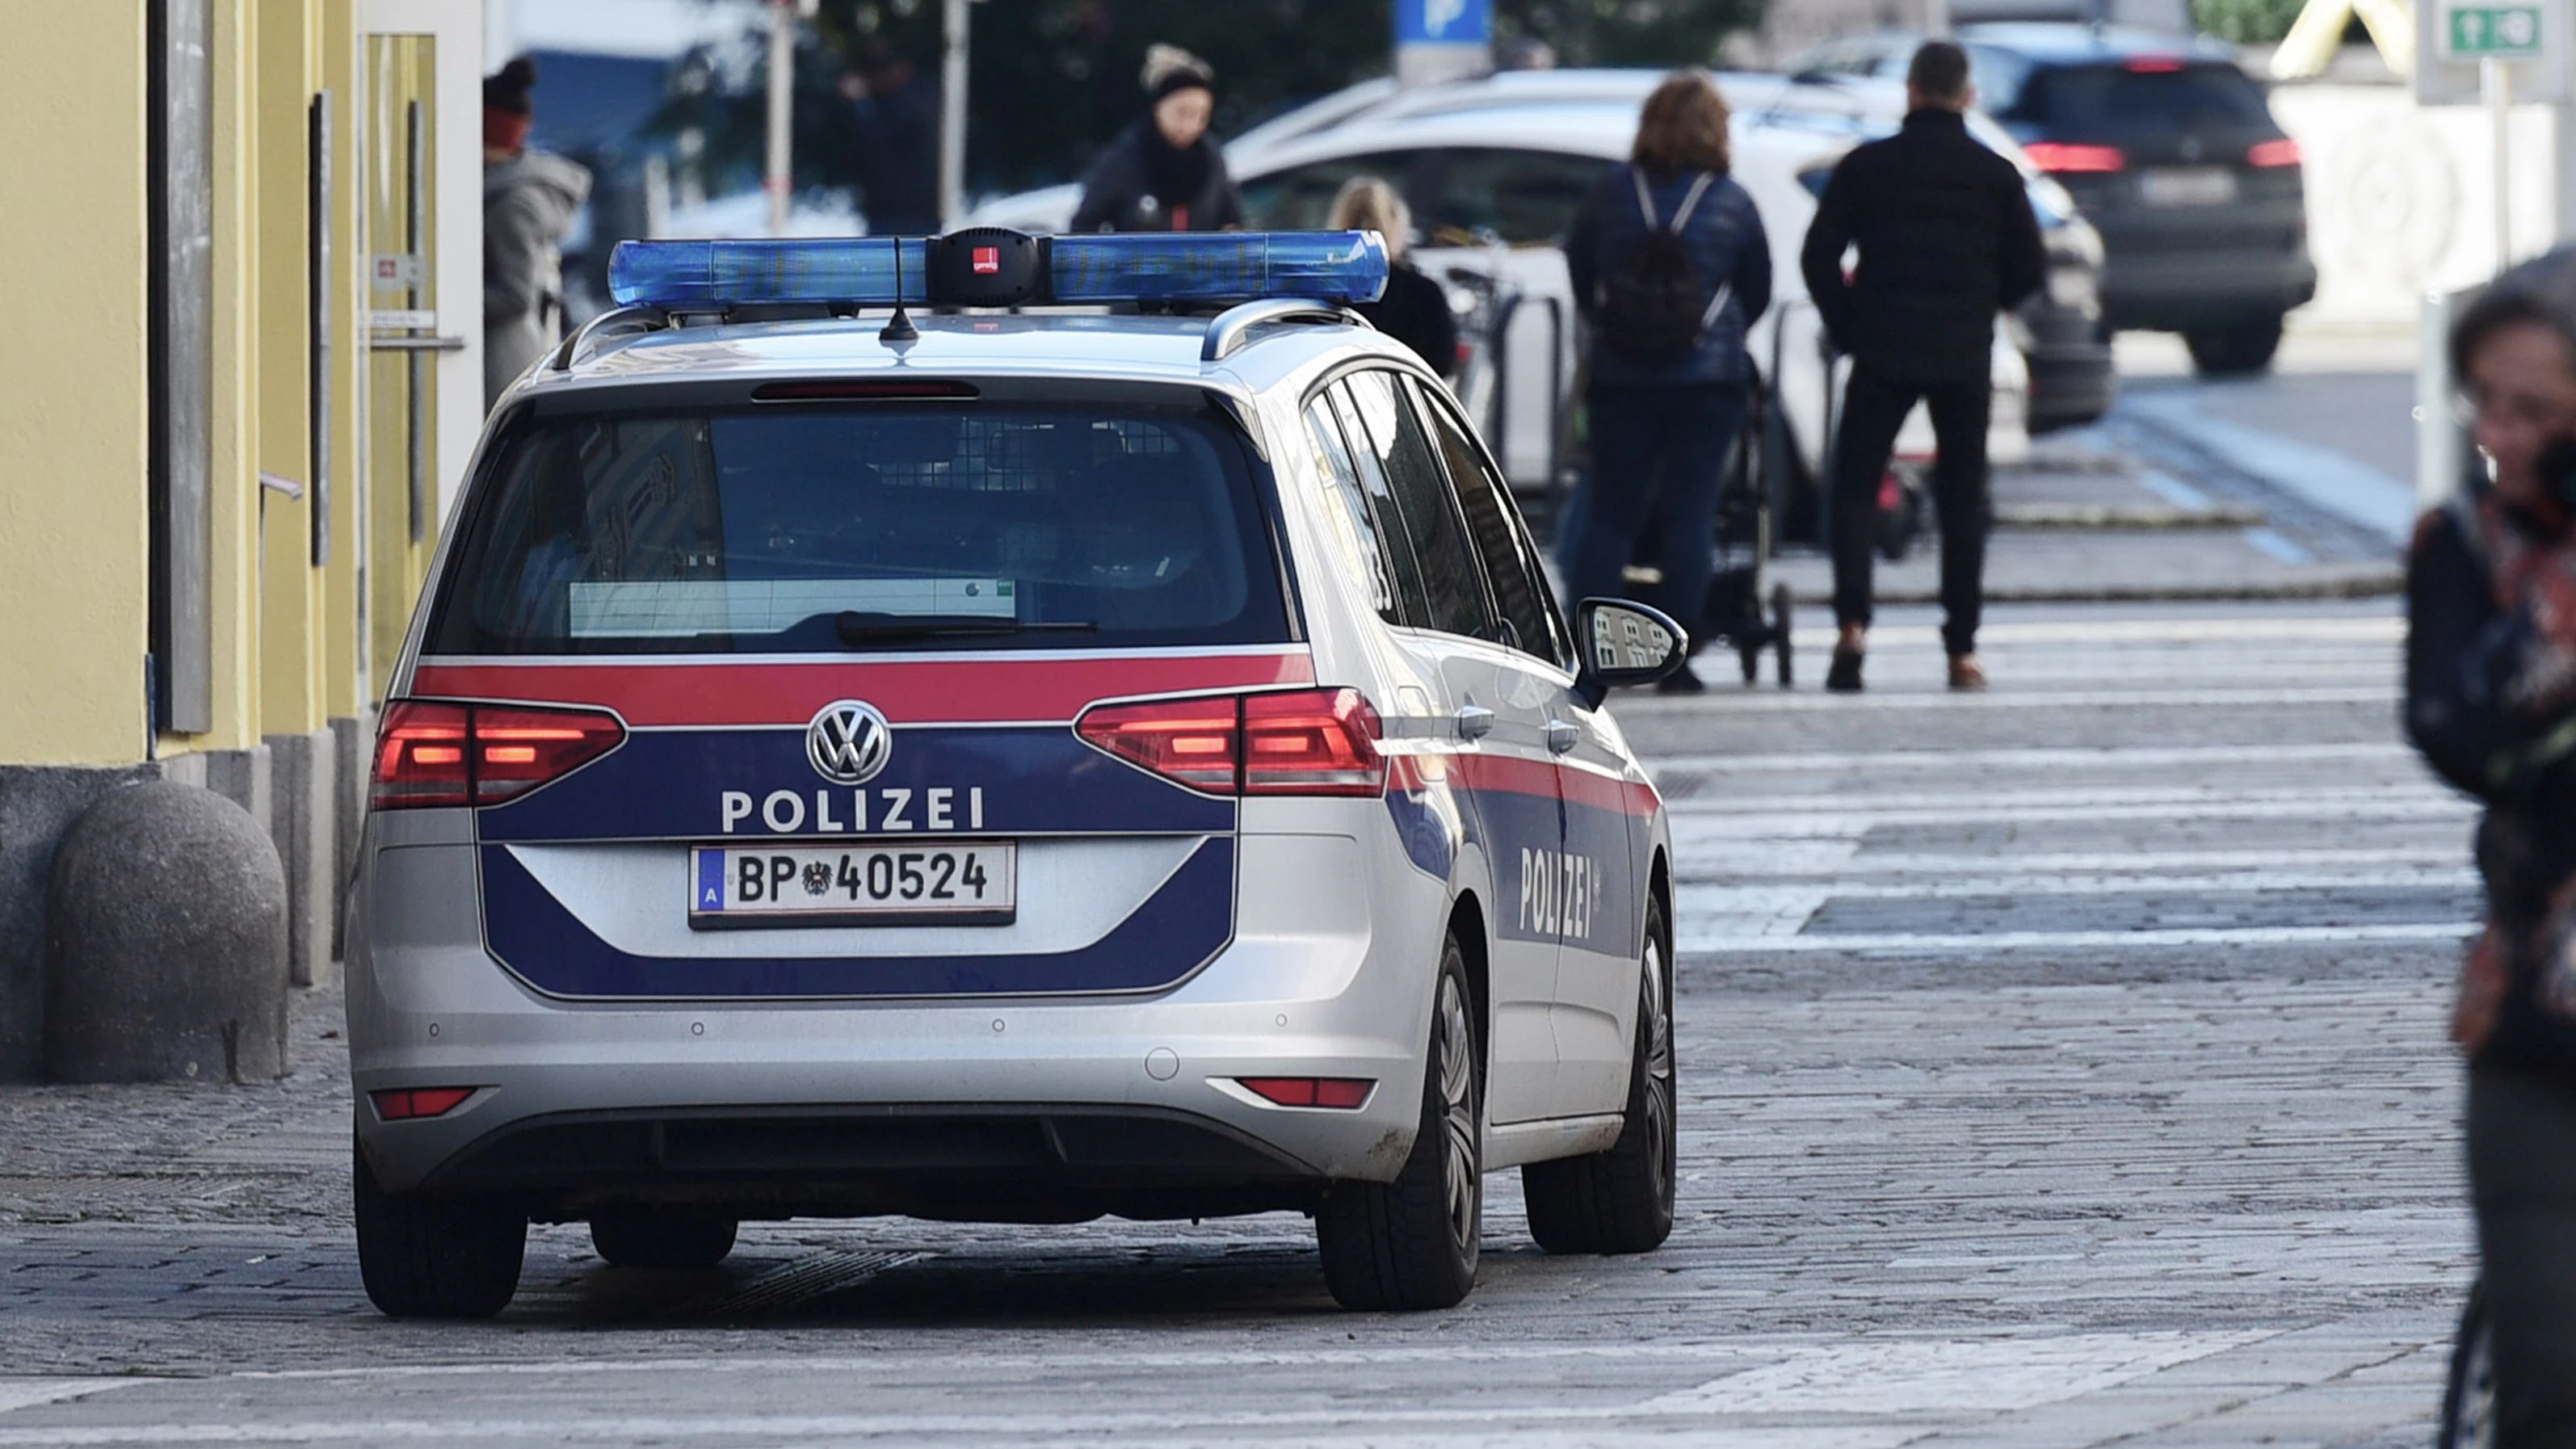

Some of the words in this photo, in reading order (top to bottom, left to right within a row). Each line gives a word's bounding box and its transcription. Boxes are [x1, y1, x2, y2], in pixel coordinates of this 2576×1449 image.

[809, 703, 889, 782] VW
[721, 786, 984, 834] POLIZEI
[704, 887, 718, 903] A
[738, 855, 797, 902] BP
[836, 852, 987, 901] 40524
[1519, 846, 1591, 940] POLIZEI
